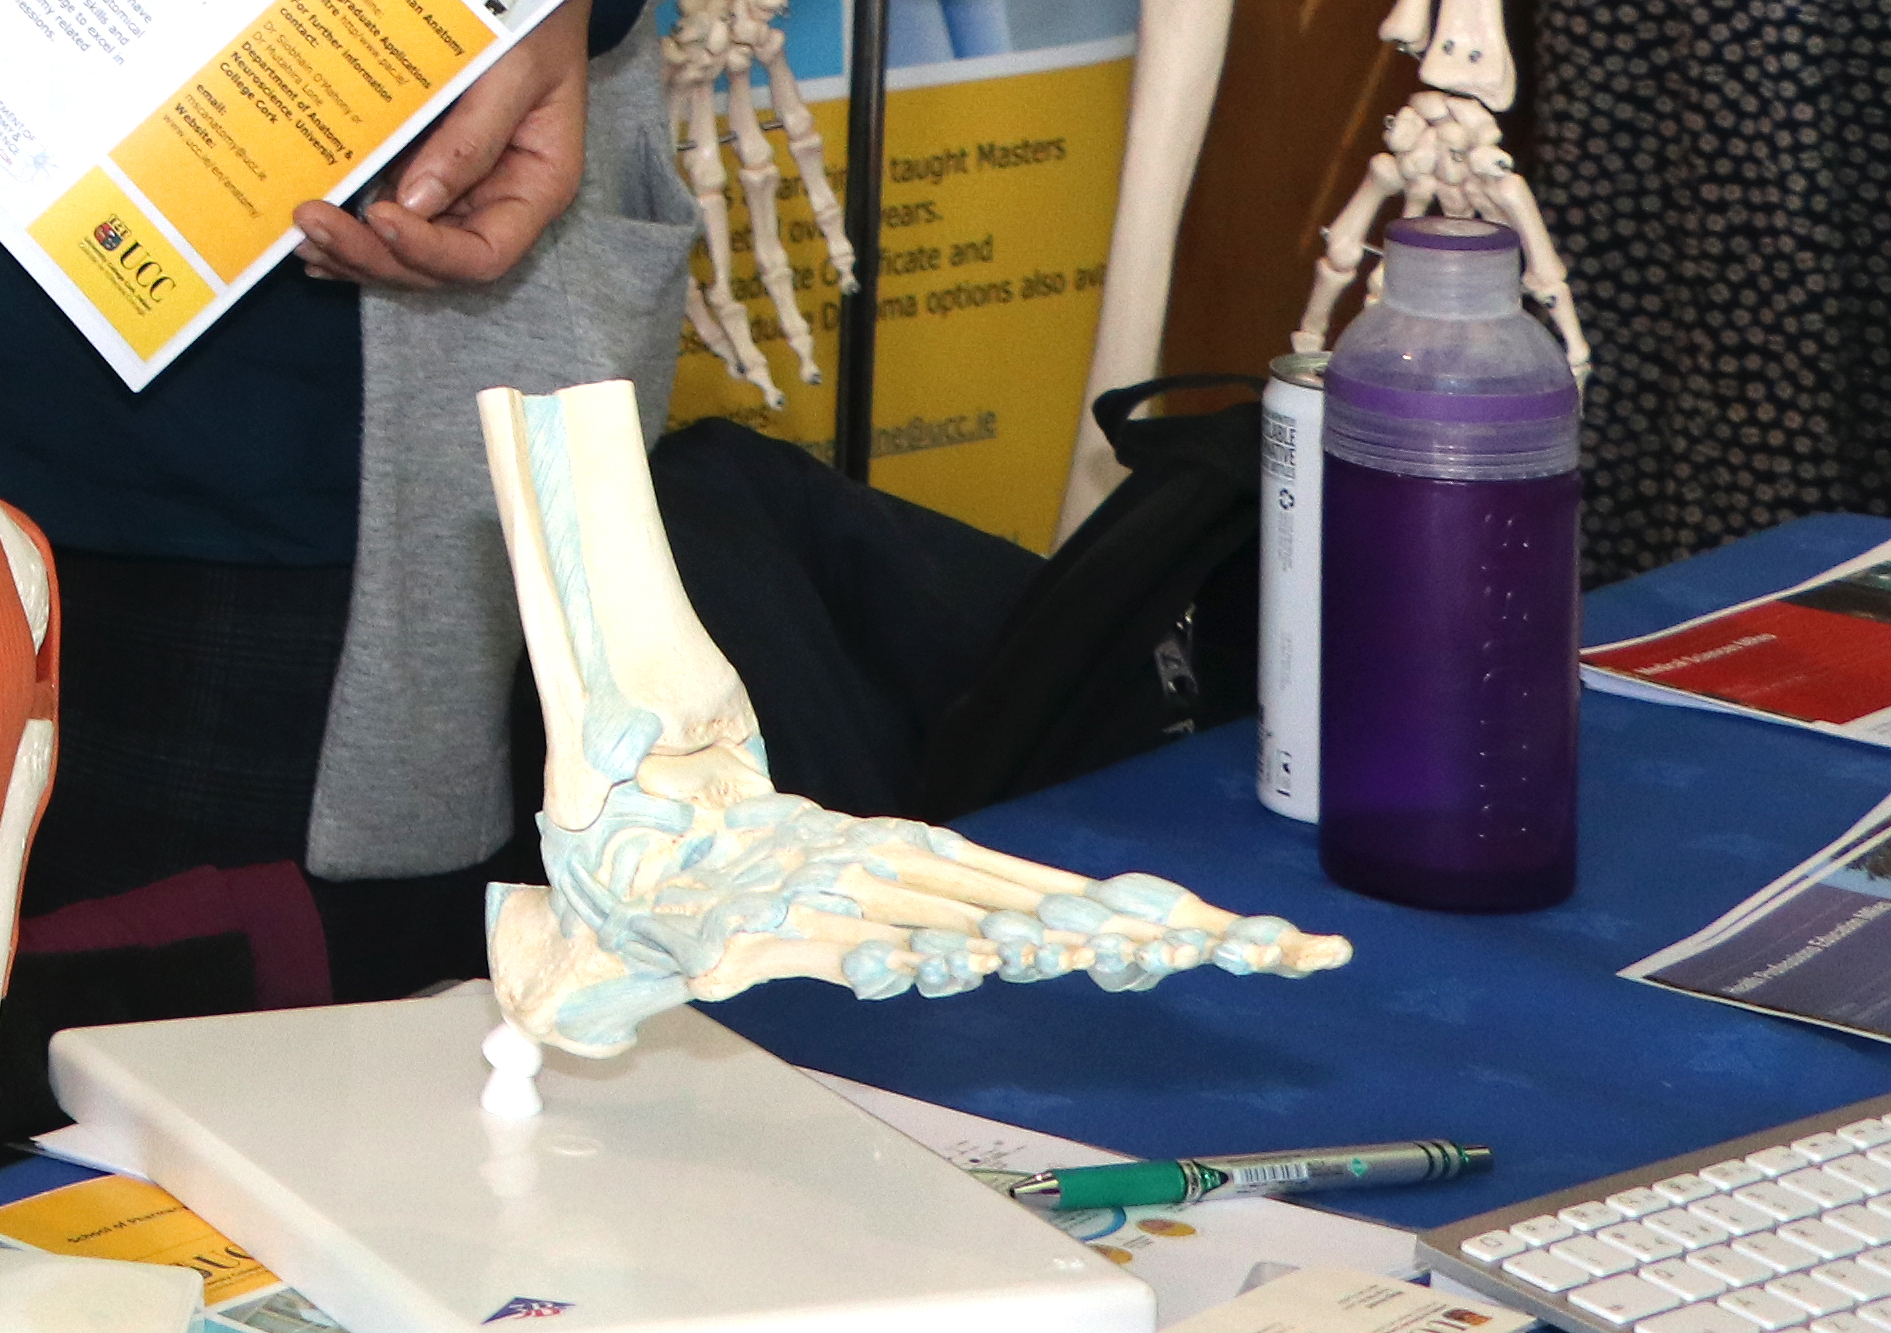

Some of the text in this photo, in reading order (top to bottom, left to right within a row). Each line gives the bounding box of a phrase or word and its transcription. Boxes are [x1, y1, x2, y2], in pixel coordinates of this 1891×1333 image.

[53, 13, 91, 53] related
[73, 11, 89, 27] to
[85, 23, 115, 54] excel
[111, 51, 127, 66] in
[107, 23, 131, 47] and
[251, 30, 267, 46] Dr
[262, 20, 278, 36] Dr
[278, 5, 321, 49] contact:
[420, 11, 466, 59] Anatomy
[307, 12, 345, 52] further
[340, 47, 395, 104] information
[377, 34, 433, 92] Applications
[194, 81, 228, 117] email:
[216, 60, 280, 125] College Cork
[238, 40, 356, 161] Department of Anatomy &
[173, 102, 218, 149] Website:
[291, 118, 339, 168] University
[889, 147, 969, 185] taught
[976, 136, 1067, 170] Masters
[120, 241, 177, 304] UCC
[949, 235, 994, 267] and
[926, 279, 1014, 318] options
[1021, 269, 1066, 300] also
